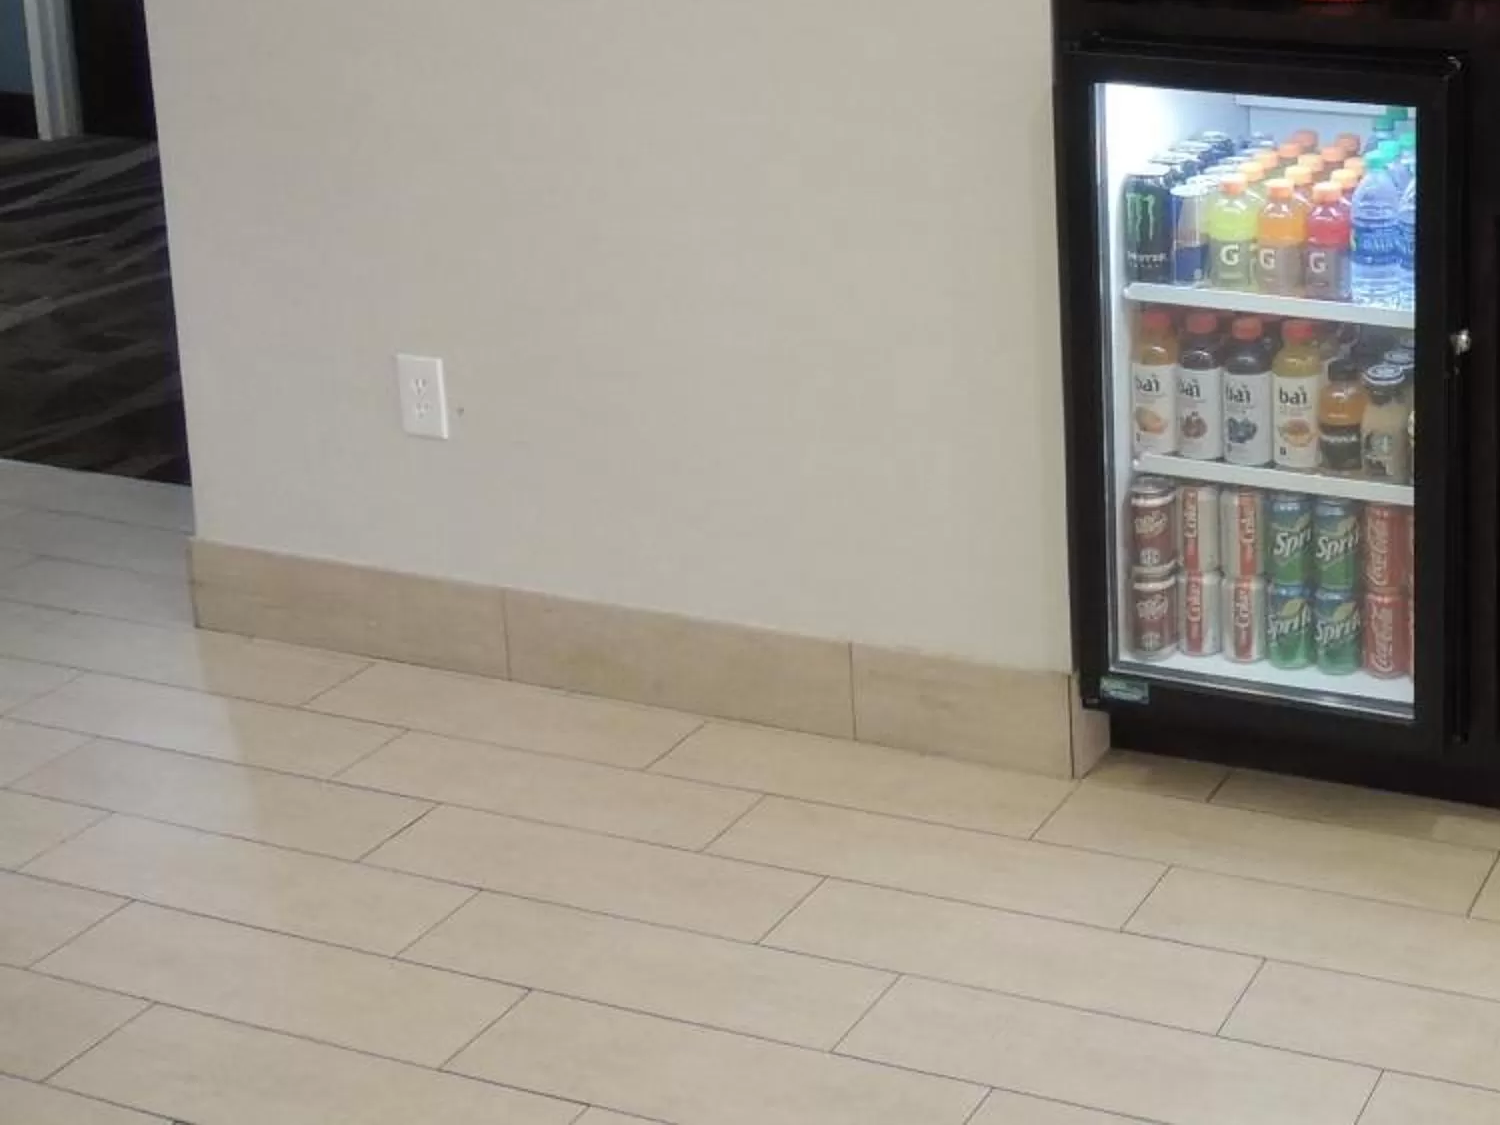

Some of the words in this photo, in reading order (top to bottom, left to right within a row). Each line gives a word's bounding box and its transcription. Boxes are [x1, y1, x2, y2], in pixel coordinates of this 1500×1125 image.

[1220, 243, 1240, 266] G
[1259, 248, 1276, 270] G
[1309, 252, 1326, 273] G
[1279, 386, 1307, 404] bai
